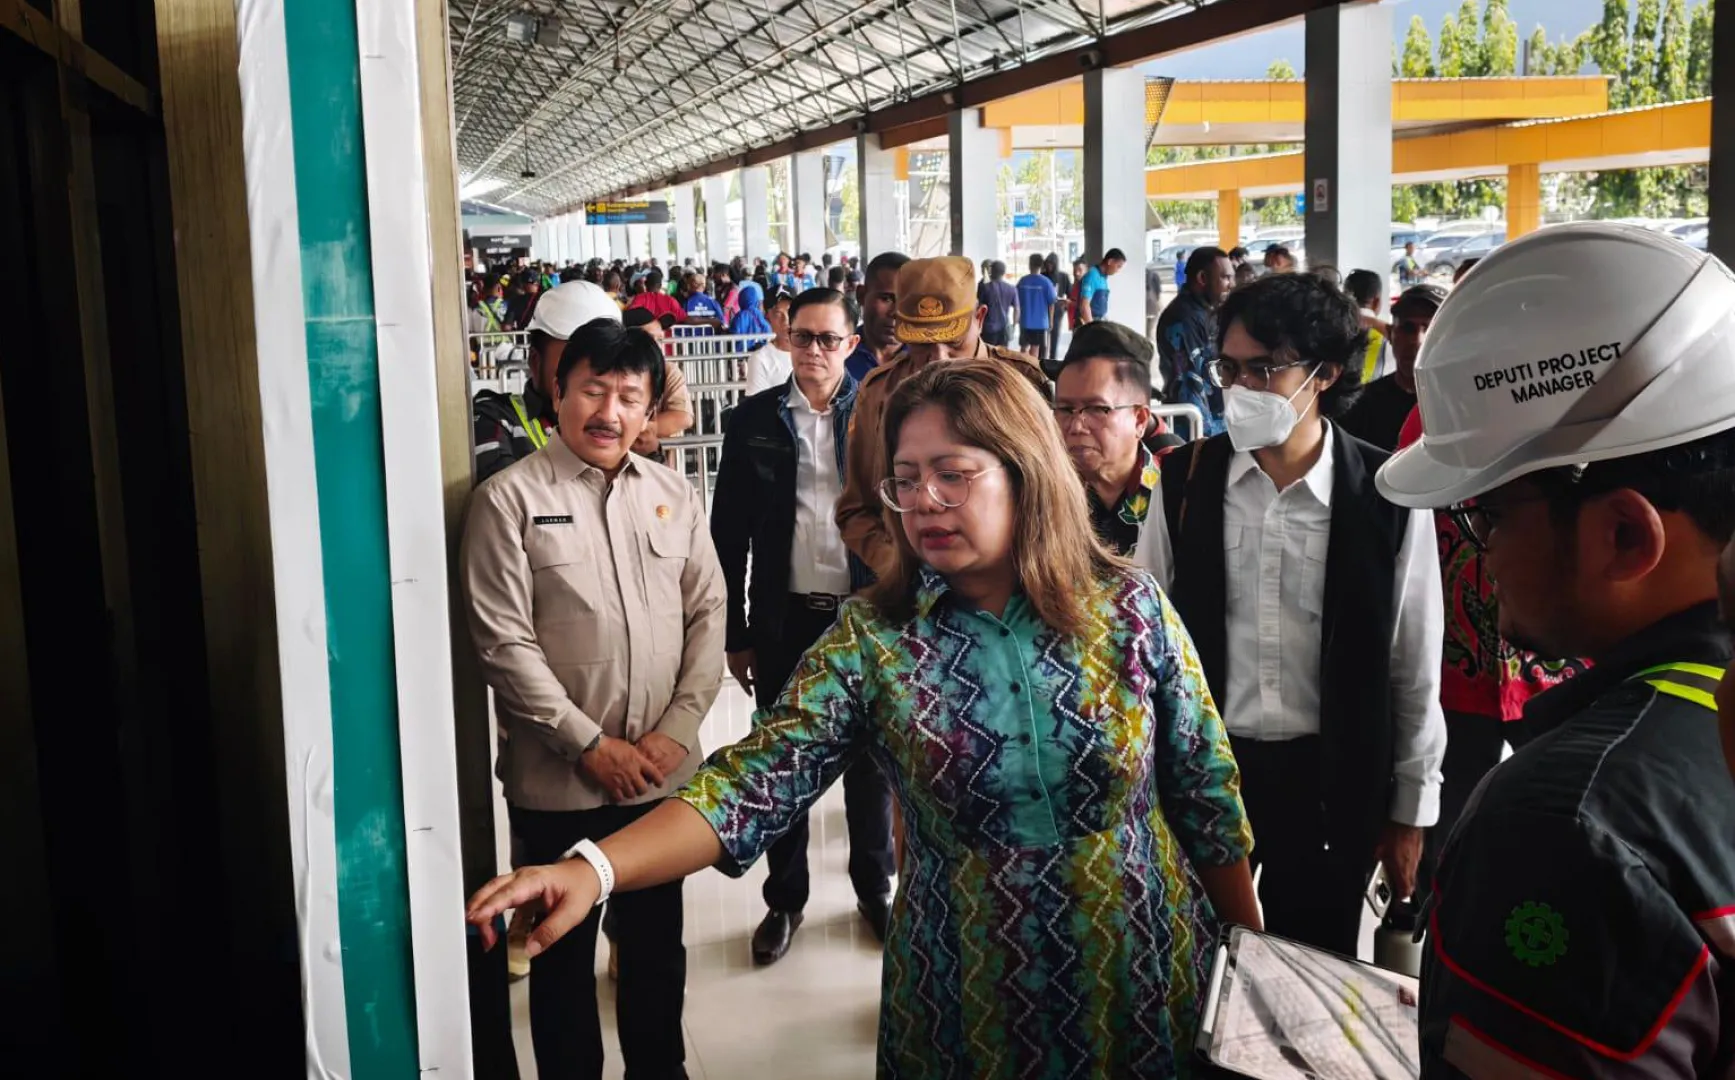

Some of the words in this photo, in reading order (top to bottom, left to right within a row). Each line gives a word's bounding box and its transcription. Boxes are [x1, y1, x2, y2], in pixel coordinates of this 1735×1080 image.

[1473, 363, 1533, 391] DEPUTI
[1537, 342, 1622, 376] PROJECT
[1511, 369, 1597, 404] MANAGER
